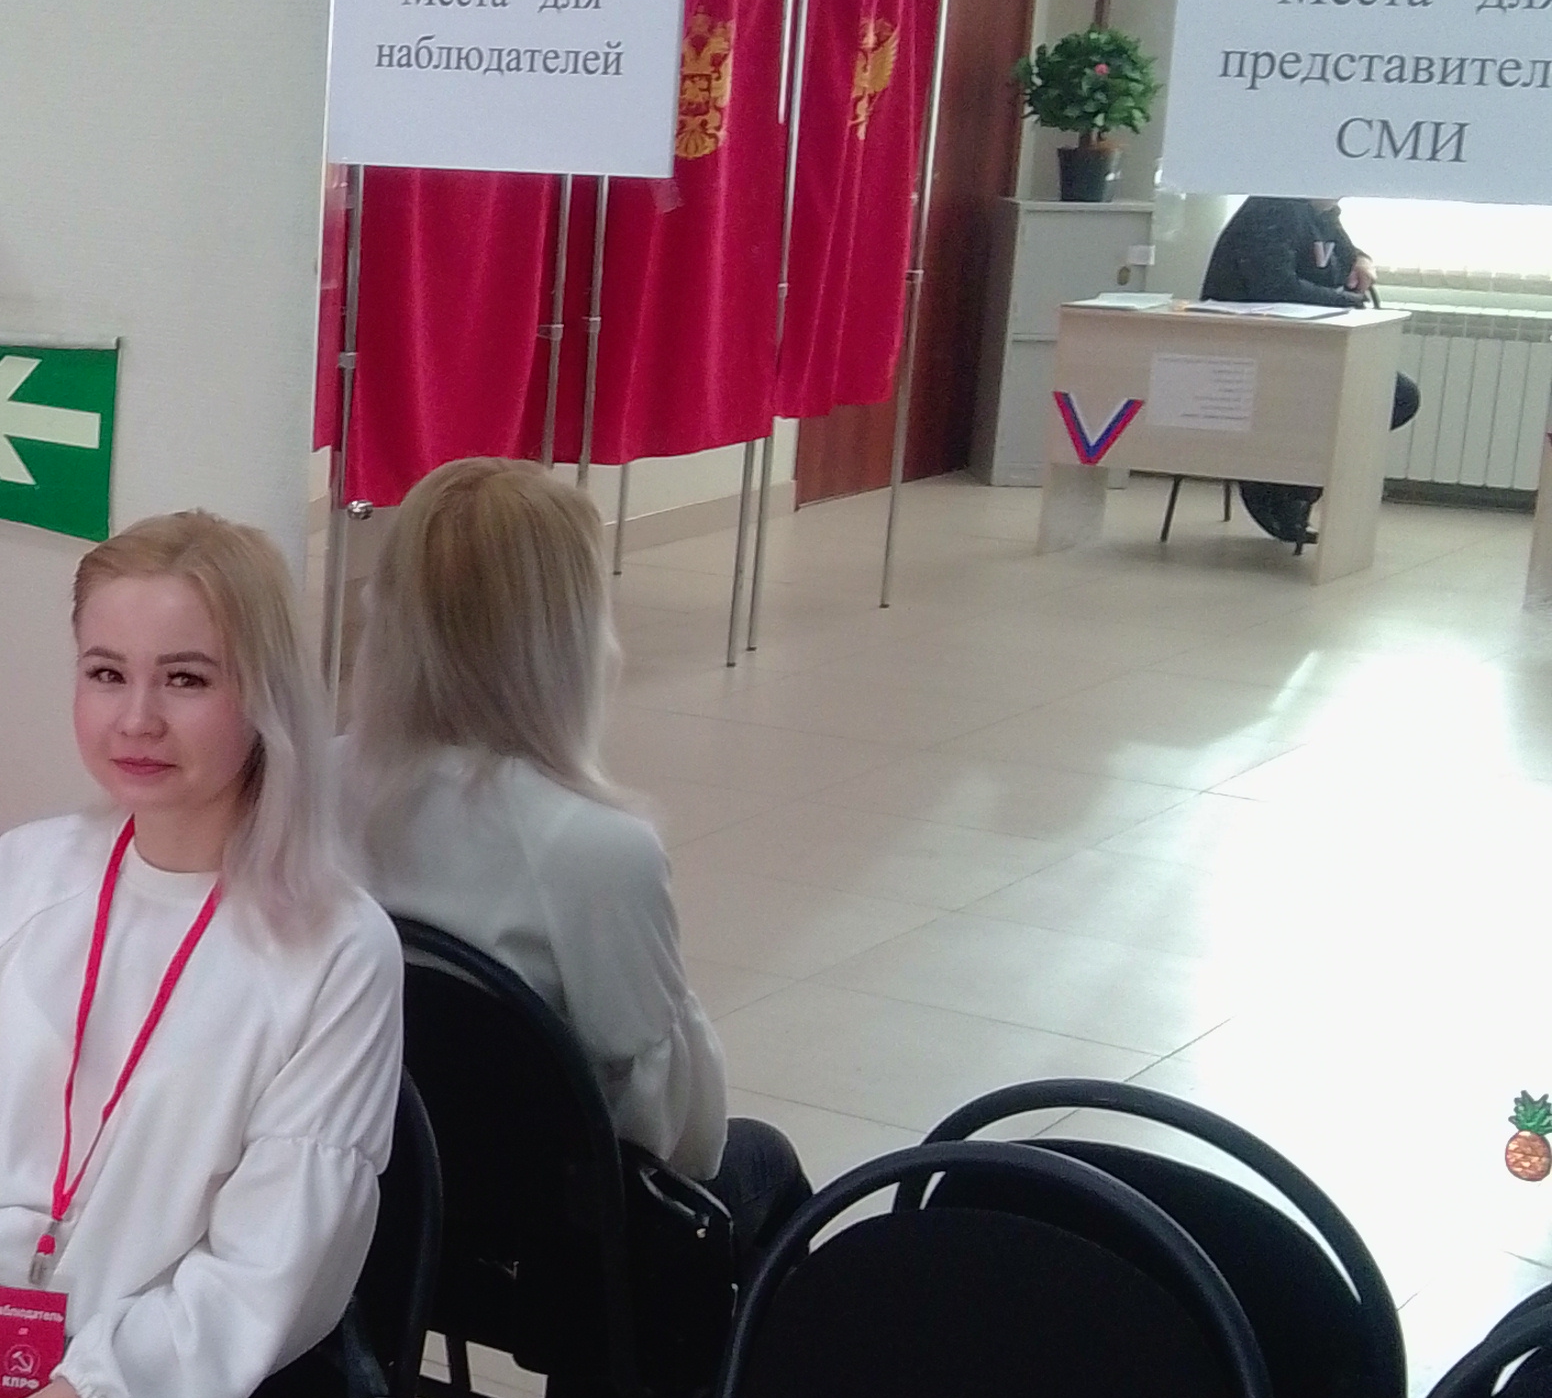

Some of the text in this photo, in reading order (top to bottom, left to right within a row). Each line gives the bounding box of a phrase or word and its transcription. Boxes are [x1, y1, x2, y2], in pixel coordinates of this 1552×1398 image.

[375, 34, 623, 77] наблюдателей
[1336, 117, 1471, 163] СМИ
[2, 1375, 40, 1389] КПРФ
